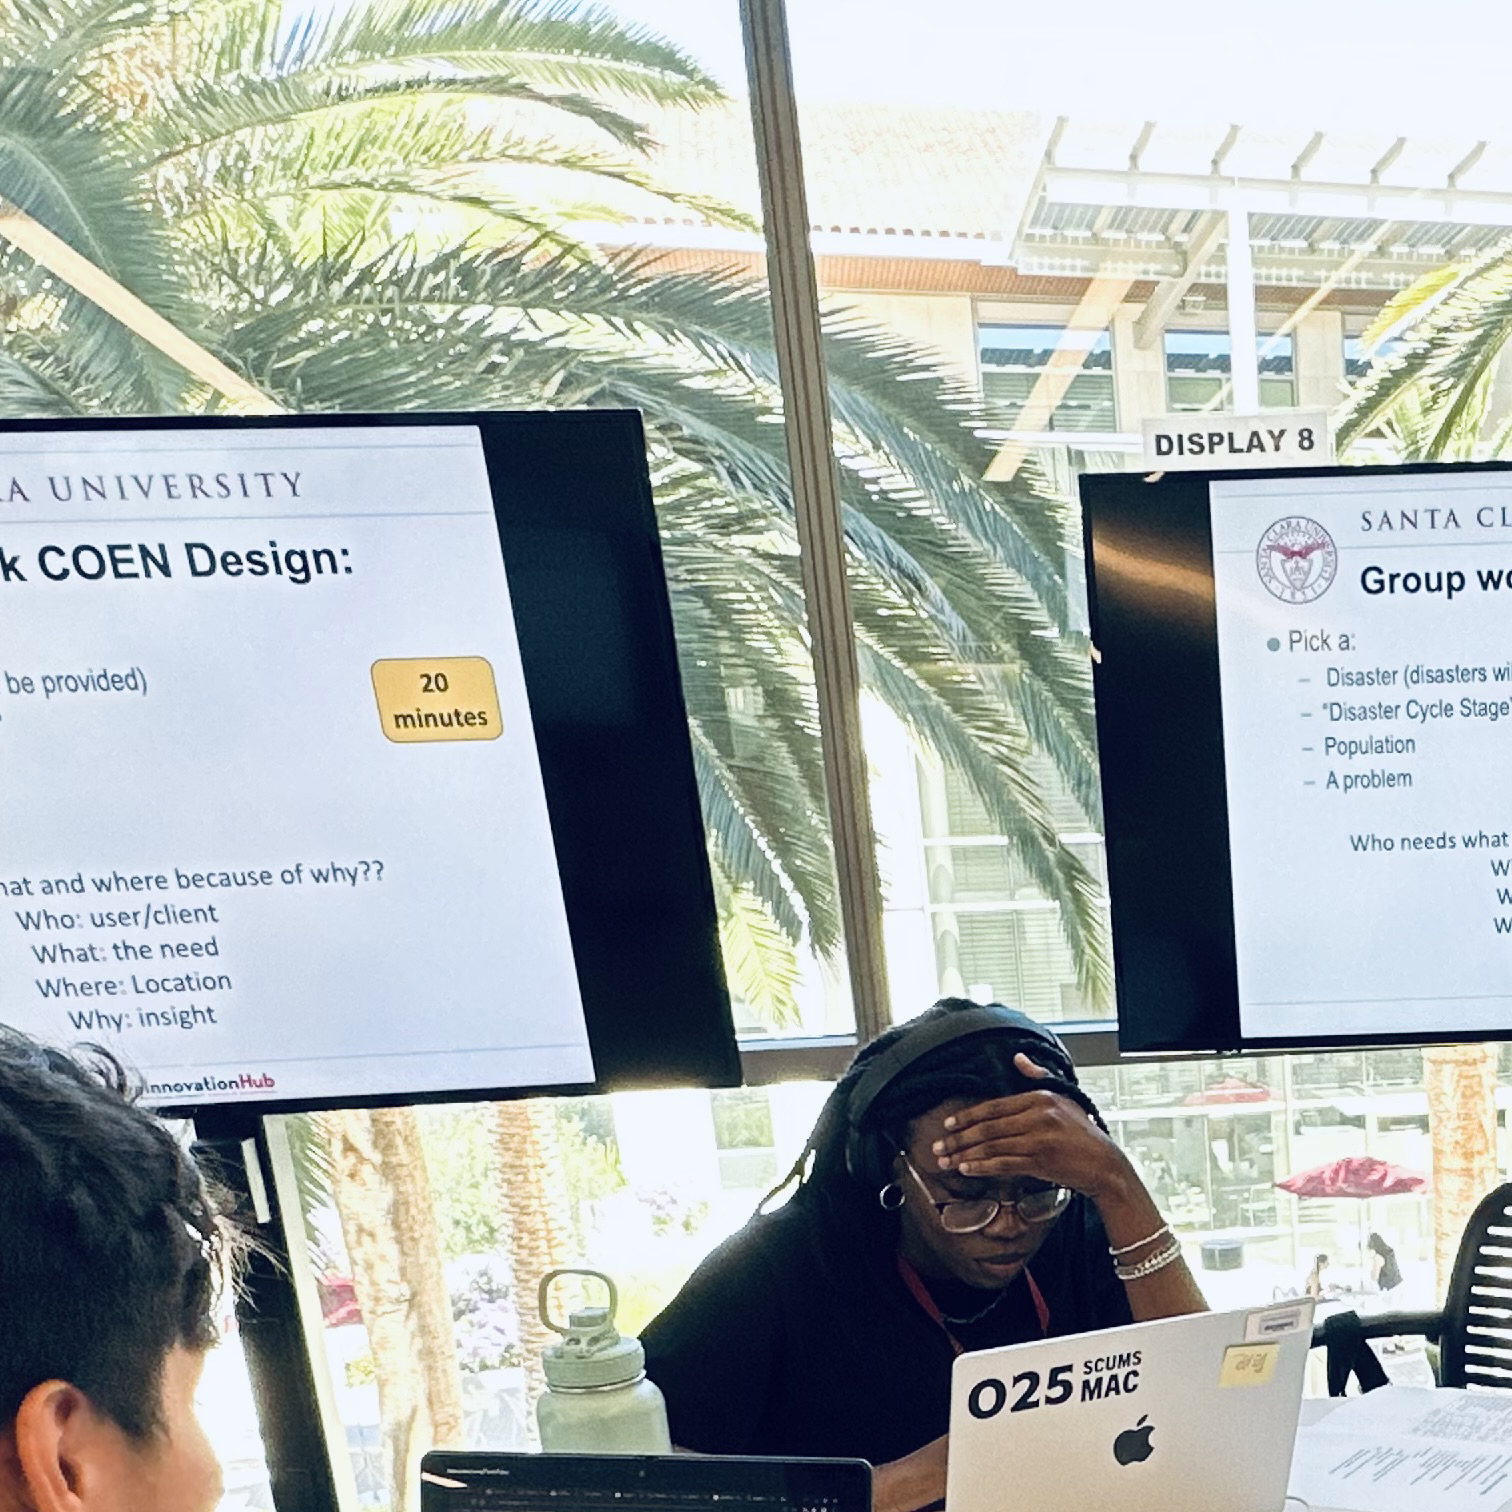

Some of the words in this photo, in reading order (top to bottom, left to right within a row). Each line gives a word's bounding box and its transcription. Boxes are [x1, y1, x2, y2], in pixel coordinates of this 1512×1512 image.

[1155, 429, 1286, 458] DISPLAY
[1297, 428, 1315, 452] 8
[48, 471, 303, 502] UNIVERSITY
[1361, 508, 1462, 531] SANTA
[38, 542, 171, 581] COEN
[187, 541, 353, 584] Design:
[1361, 565, 1466, 599] Group
[1288, 629, 1332, 652] Pick
[1338, 633, 1356, 651] a:
[5, 671, 35, 694] be
[42, 666, 148, 699] provided)
[420, 672, 449, 694] 20
[1326, 667, 1398, 687] Disaster
[1403, 663, 1487, 689] (disasters
[393, 706, 488, 730] minutes
[1322, 701, 1400, 722] "Disaster
[1405, 699, 1454, 724] Cycle
[1324, 735, 1415, 760] Population
[1326, 771, 1339, 790] A
[1343, 770, 1413, 794] problem
[1350, 833, 1395, 852] Who
[1400, 833, 1456, 851] needs
[1462, 831, 1509, 849] what
[0, 877, 34, 896] at
[39, 872, 85, 896] and
[91, 870, 169, 893] where
[174, 866, 273, 890] because
[280, 863, 304, 885] of
[311, 860, 384, 887] why??
[15, 908, 84, 931] Who:
[90, 902, 219, 929] user/client
[31, 942, 107, 964] What:
[112, 939, 154, 961] the
[159, 935, 219, 960] need
[35, 976, 127, 999] Where:
[131, 971, 232, 995] Location
[67, 1008, 133, 1034] Why:
[136, 1003, 218, 1030] insight
[1083, 1350, 1142, 1375] SCUMS
[1081, 1370, 1140, 1402] MAC
